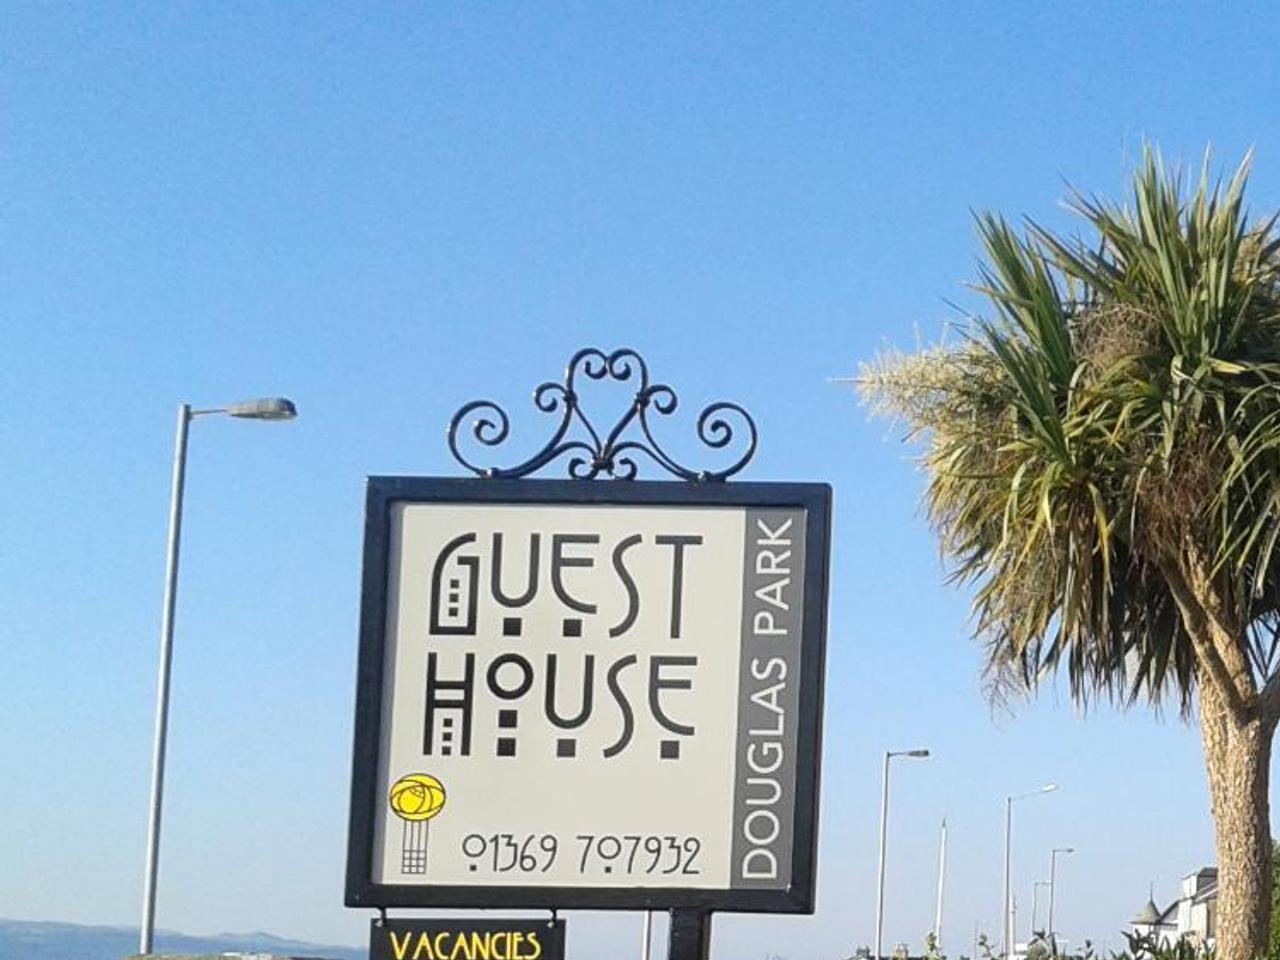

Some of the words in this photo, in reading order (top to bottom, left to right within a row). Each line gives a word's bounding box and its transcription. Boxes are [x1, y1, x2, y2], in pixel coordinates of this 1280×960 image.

[429, 532, 703, 639] GUEST
[752, 517, 793, 636] PARK
[423, 652, 698, 760] HOUSE
[741, 657, 788, 881] DOUGLAS
[462, 833, 558, 872] 01369
[577, 834, 701, 874] 707932
